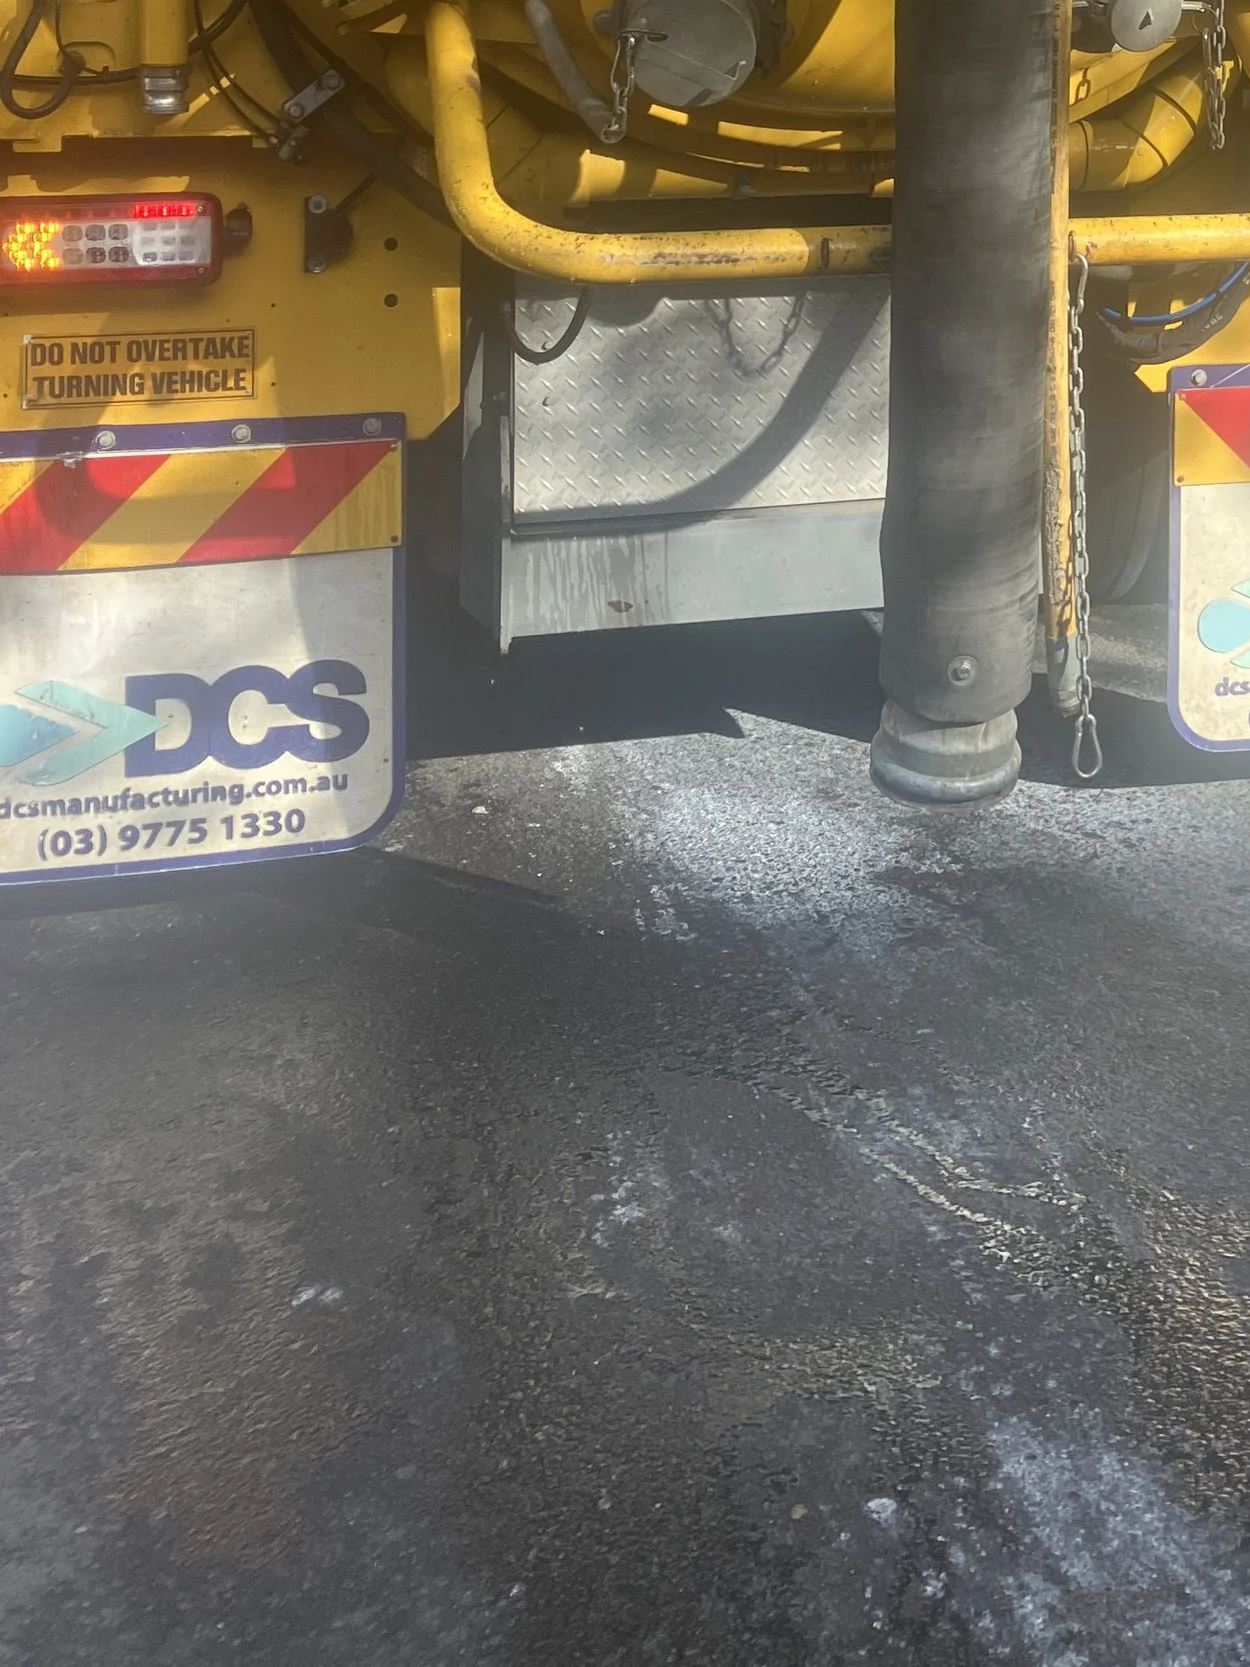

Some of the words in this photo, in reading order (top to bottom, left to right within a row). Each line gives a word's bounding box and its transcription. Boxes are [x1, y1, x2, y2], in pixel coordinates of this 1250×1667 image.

[30, 342, 64, 366] DO
[70, 340, 121, 365] NOT
[127, 335, 250, 363] OVERTAKE
[33, 372, 145, 399] TURNING
[151, 368, 248, 395] VEHICLE
[124, 659, 370, 778] DCS
[0, 773, 348, 820] dcsmanufacturing.com.au
[37, 824, 107, 861] (03)
[118, 817, 208, 851] 9775
[220, 808, 305, 841] 1330
